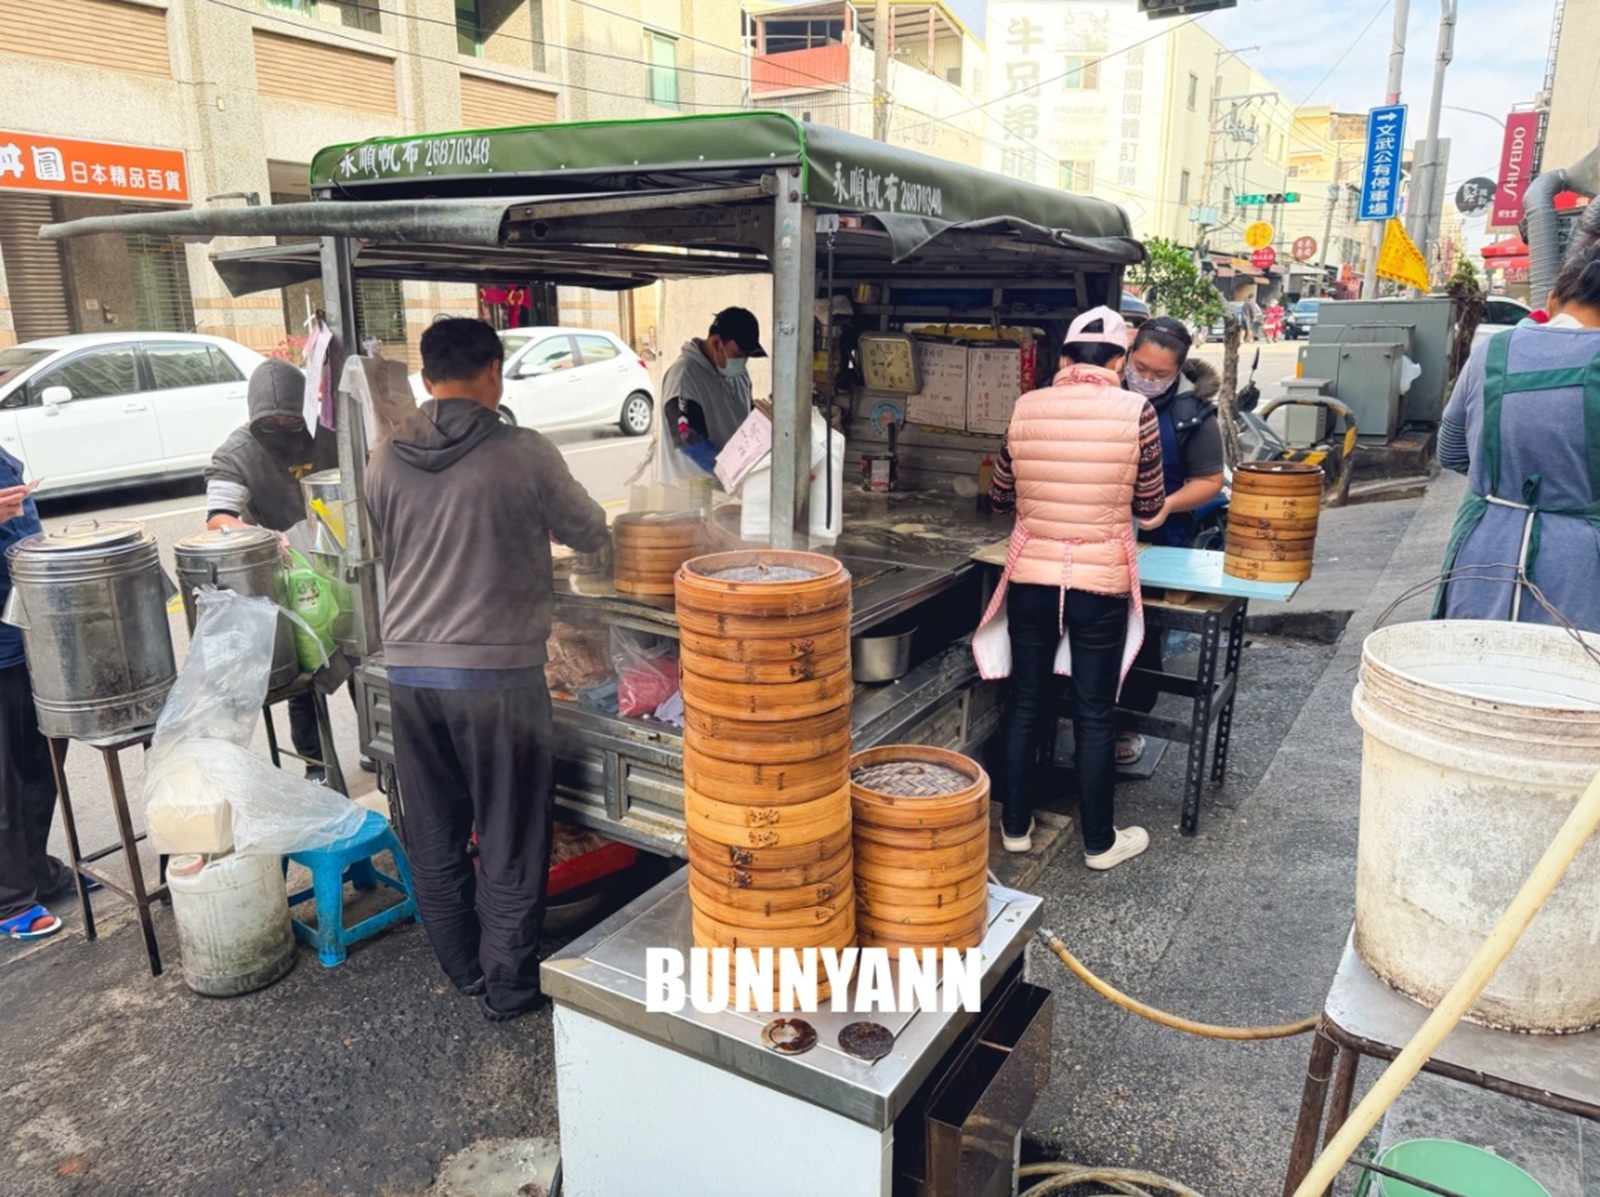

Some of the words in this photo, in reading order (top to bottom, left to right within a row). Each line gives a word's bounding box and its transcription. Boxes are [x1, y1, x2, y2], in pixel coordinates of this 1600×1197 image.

[70, 161, 182, 192] 日本精品百貨
[340, 139, 423, 178] 永順帆布
[424, 137, 490, 167] 26870348
[1367, 124, 1397, 215] 文武公有停車場
[1503, 126, 1526, 202] SHISEIDO
[833, 161, 899, 213] 永順帆布
[900, 180, 943, 216] 26870348
